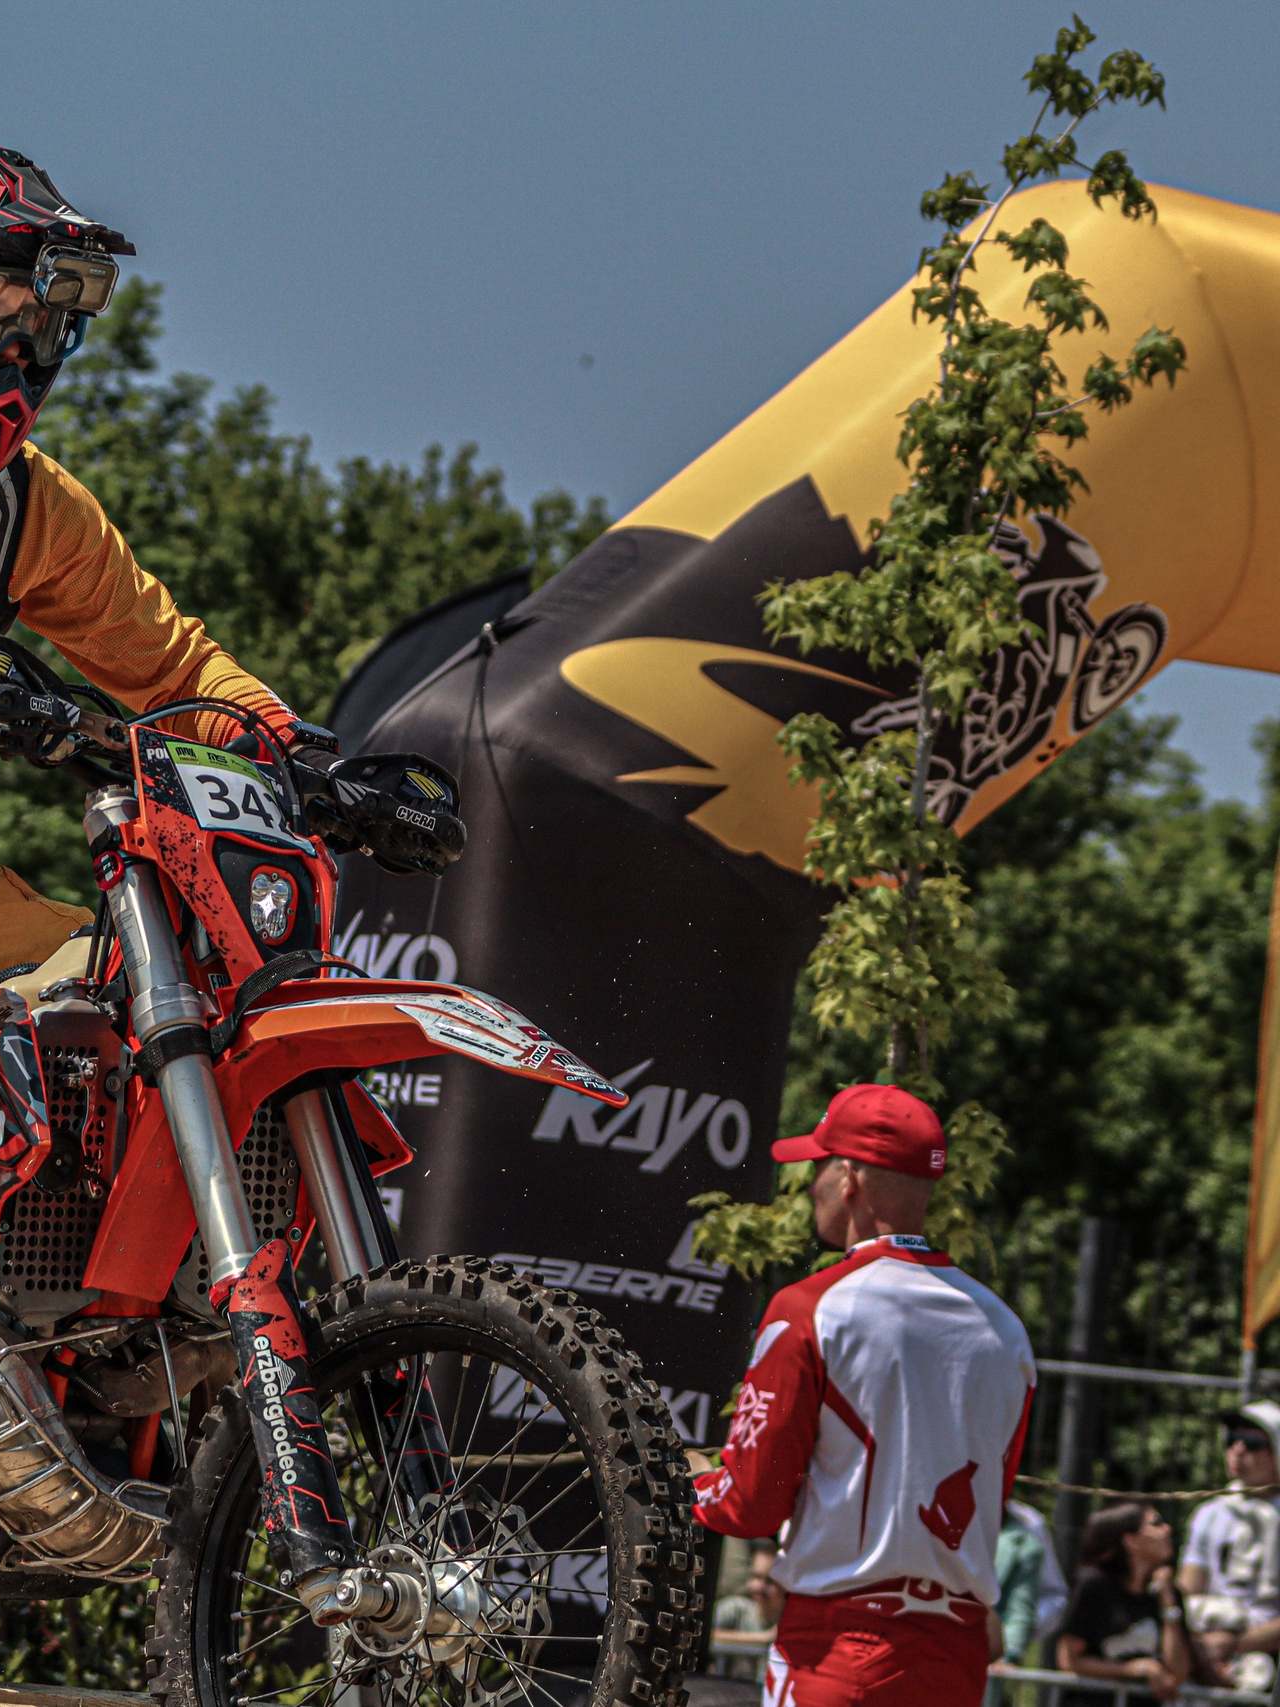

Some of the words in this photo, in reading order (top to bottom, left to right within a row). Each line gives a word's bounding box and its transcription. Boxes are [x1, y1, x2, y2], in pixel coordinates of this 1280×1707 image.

[30, 696, 53, 716] CYCRA
[395, 805, 437, 831] CYCRA
[531, 1057, 753, 1173] KAYO
[253, 1335, 299, 1486] erzbergrodeo
